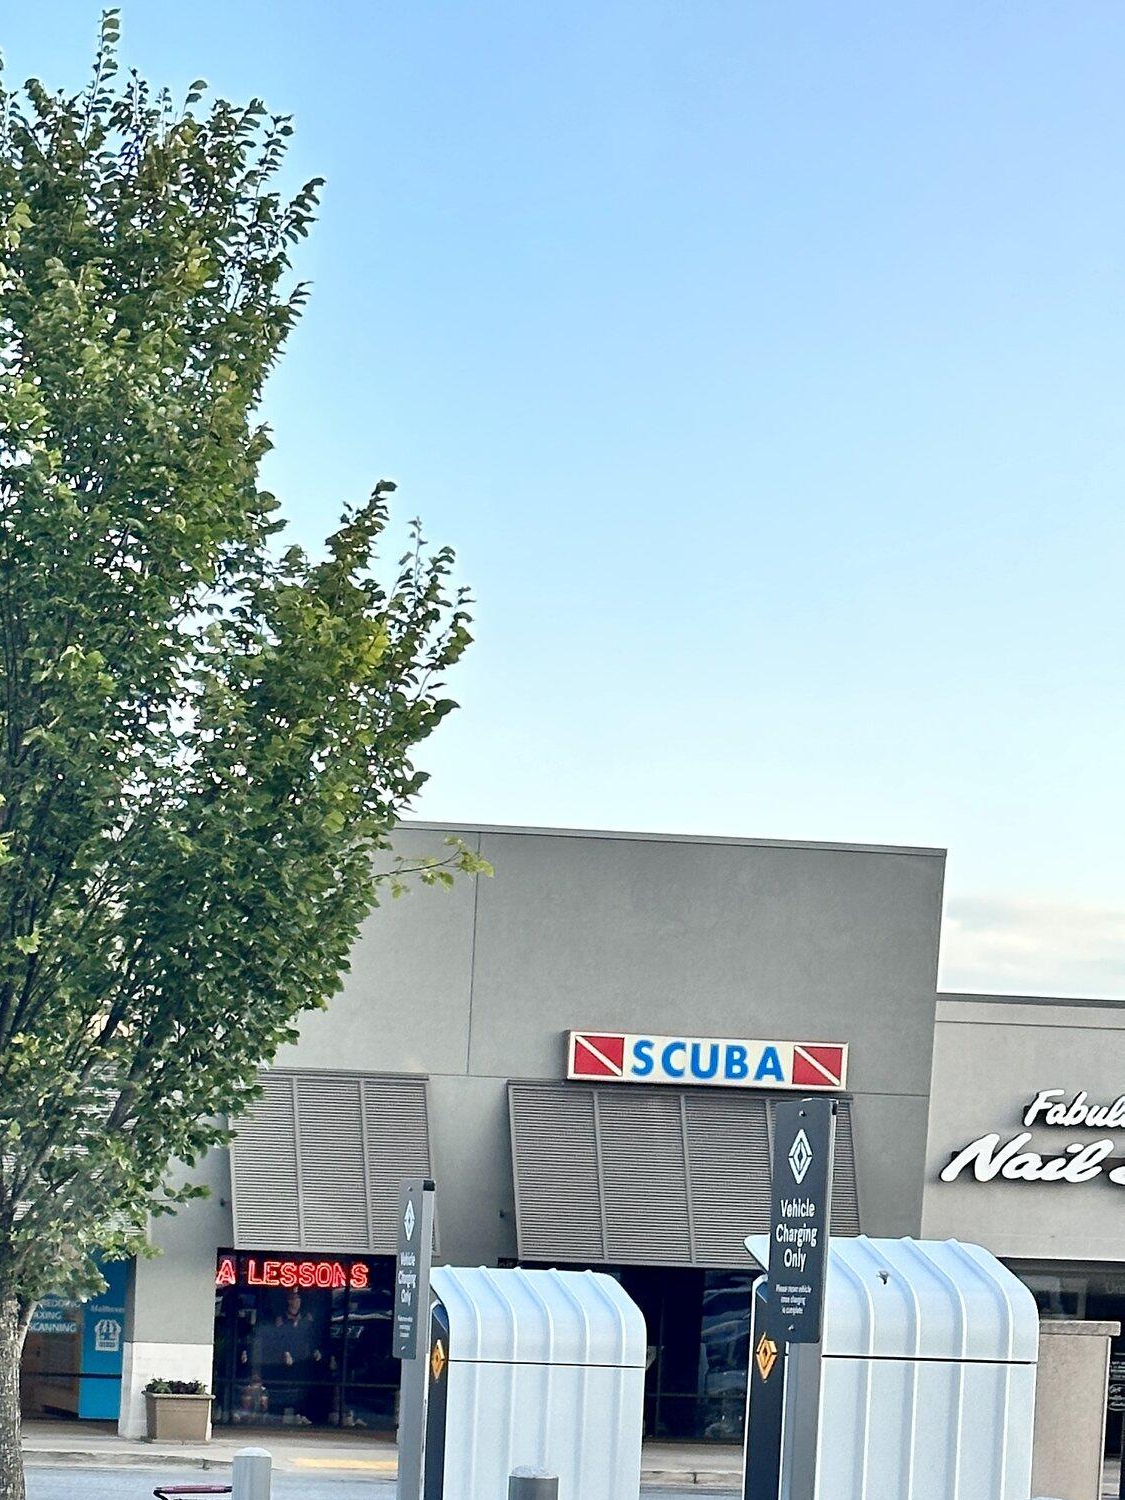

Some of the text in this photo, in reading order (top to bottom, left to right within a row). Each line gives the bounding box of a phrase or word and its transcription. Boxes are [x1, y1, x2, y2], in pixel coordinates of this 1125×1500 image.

[630, 1039, 785, 1082] SCUBA
[940, 1132, 1115, 1183] Nail
[780, 1197, 816, 1218] Vehicle
[776, 1223, 818, 1248] Charging
[784, 1248, 807, 1273] Only
[248, 1259, 369, 1288] LESSONS
[33, 1310, 62, 1320] AXING
